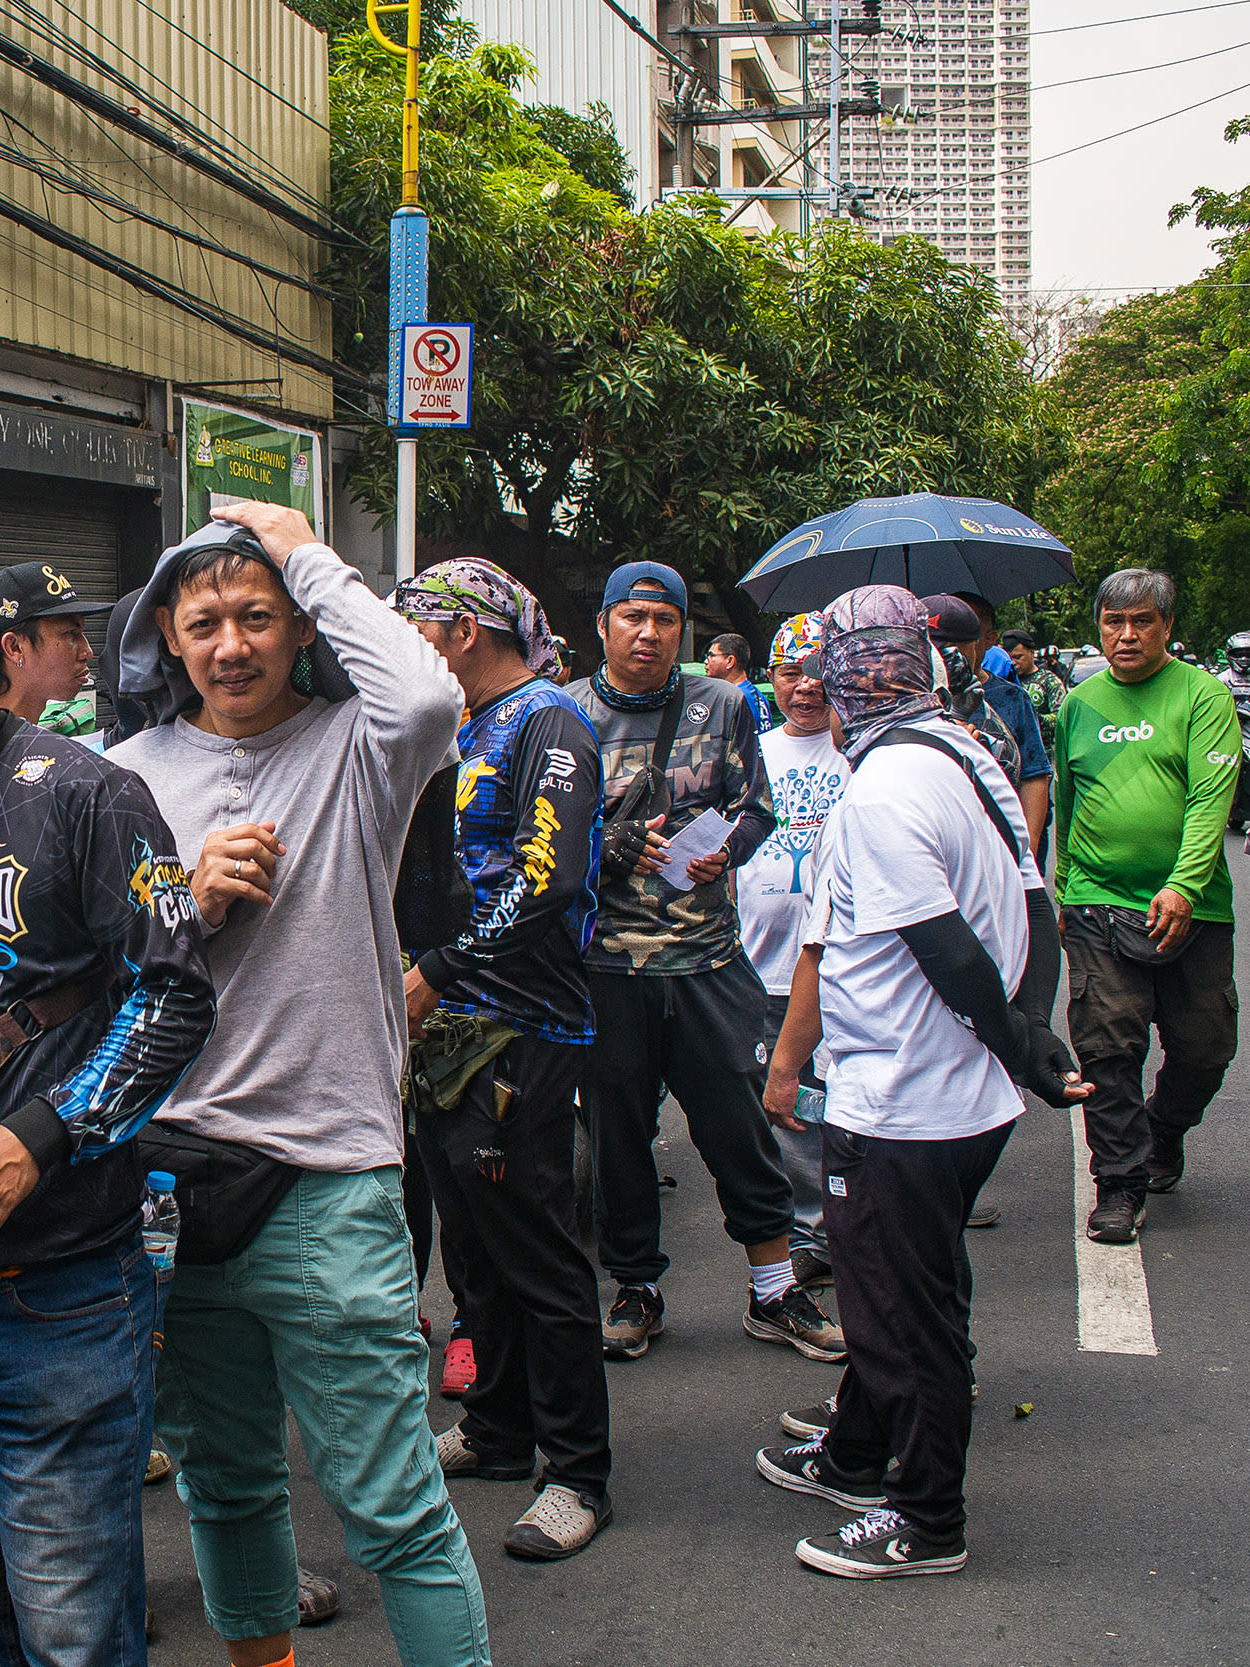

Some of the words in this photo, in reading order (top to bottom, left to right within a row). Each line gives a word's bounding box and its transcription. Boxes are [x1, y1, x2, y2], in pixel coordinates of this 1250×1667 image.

[406, 377, 432, 392] TOW
[434, 378, 465, 392] AWAY
[420, 394, 452, 408] ZONE
[214, 438, 252, 460] CREATIVE
[252, 446, 286, 470] LEARNING
[984, 523, 1020, 537] Sun
[1016, 528, 1052, 540] Life
[1098, 720, 1154, 742] Grab
[539, 776, 574, 792] BULTO
